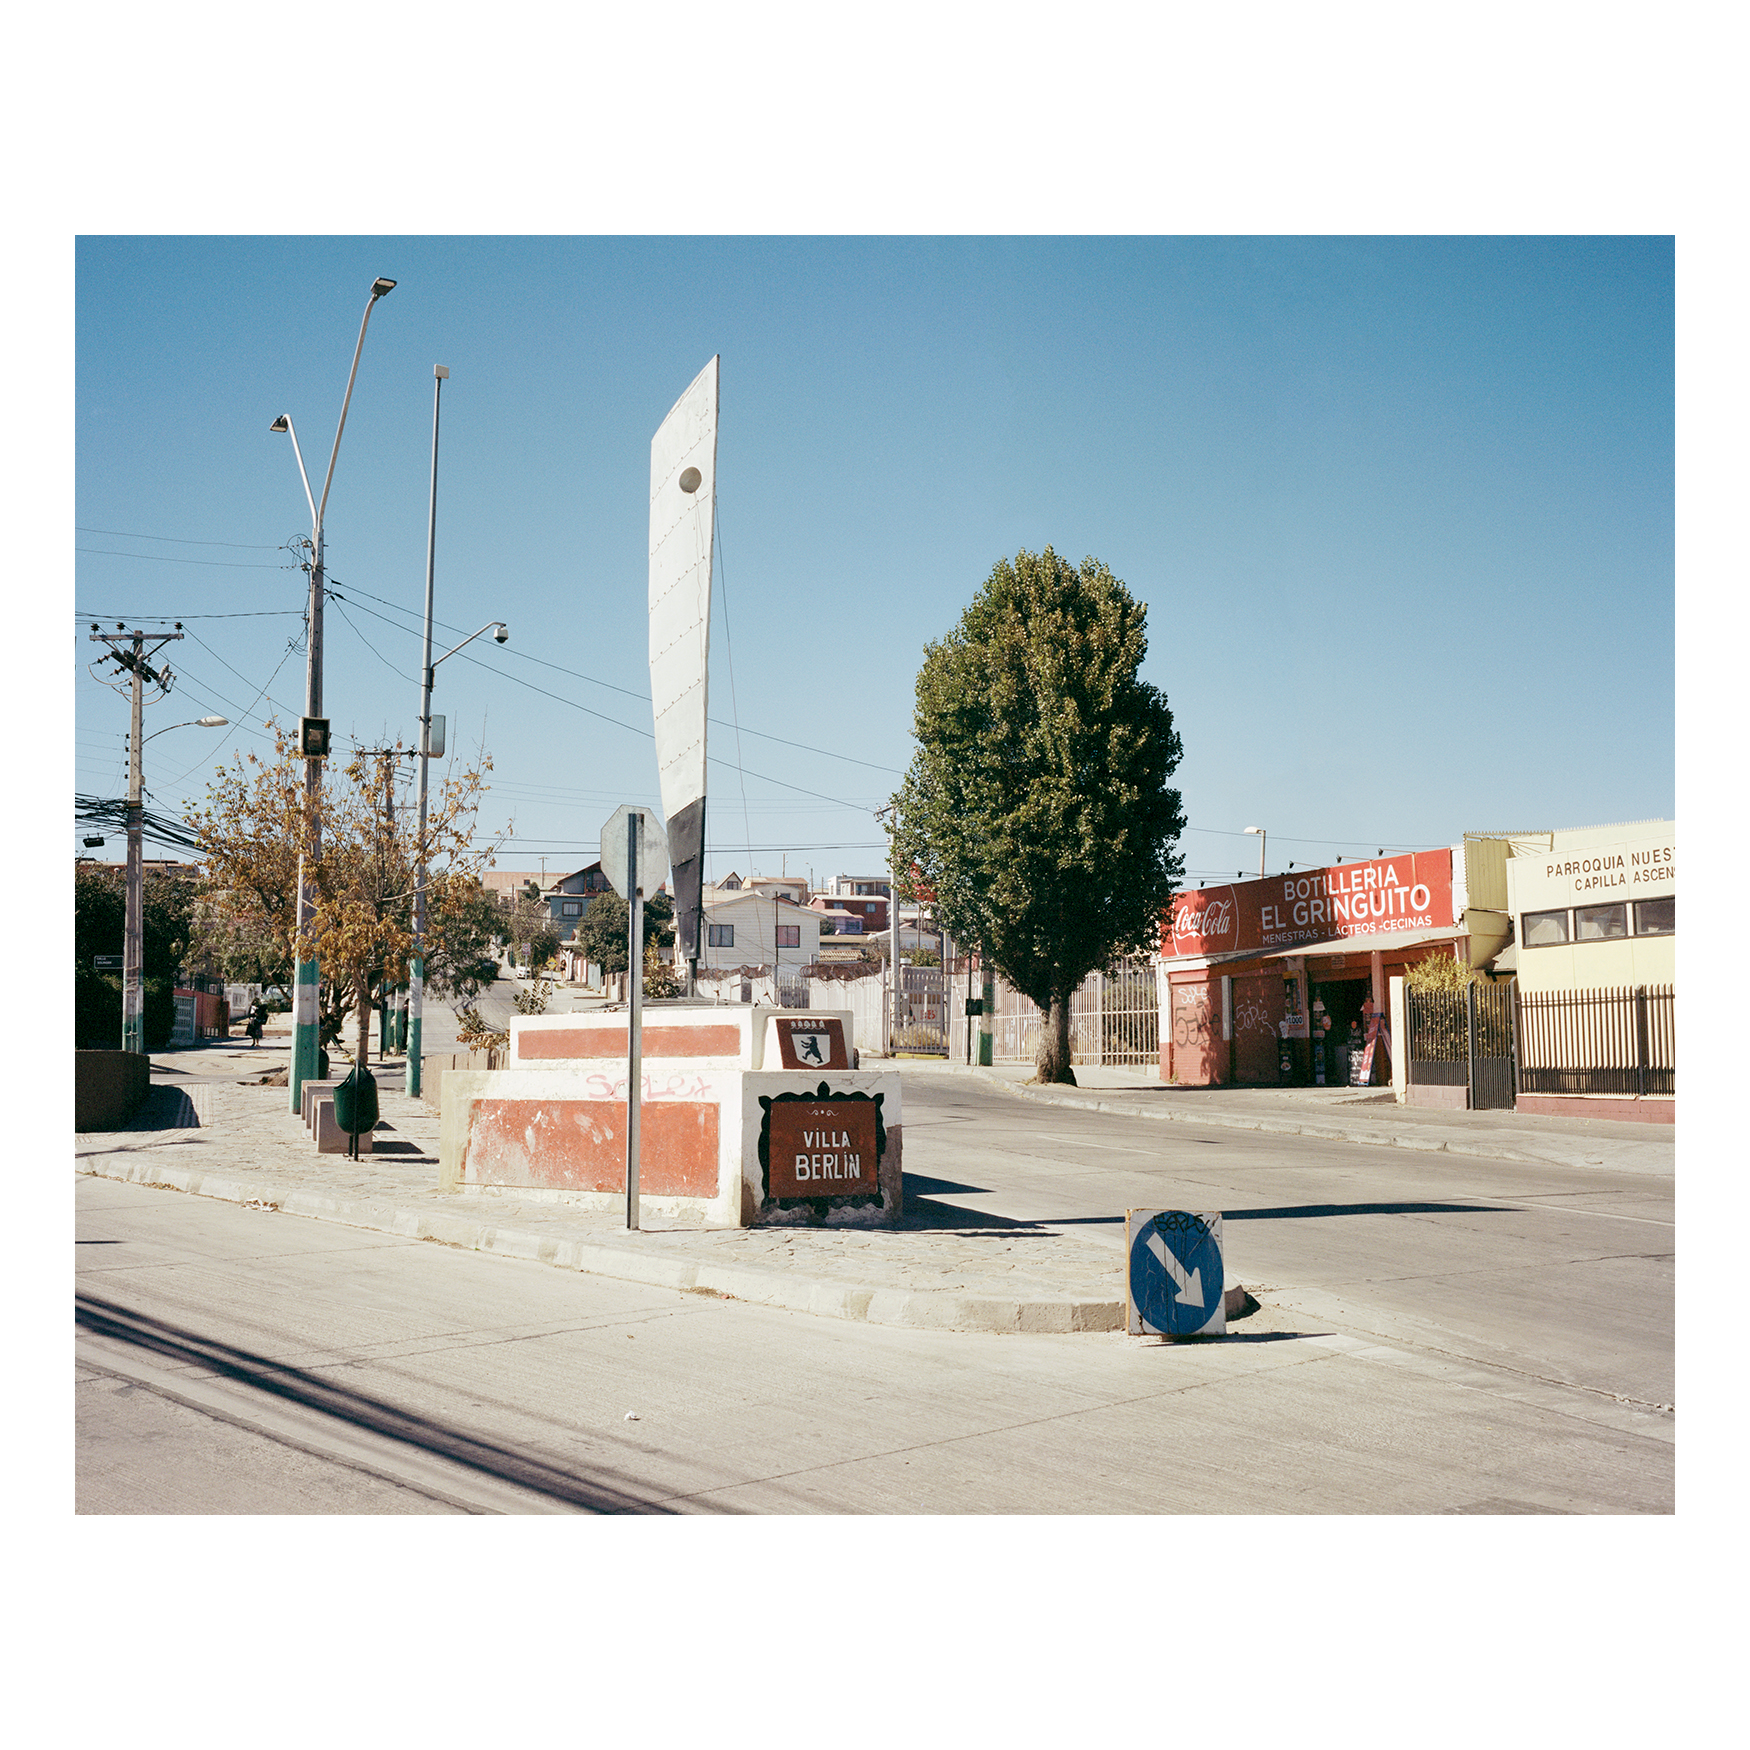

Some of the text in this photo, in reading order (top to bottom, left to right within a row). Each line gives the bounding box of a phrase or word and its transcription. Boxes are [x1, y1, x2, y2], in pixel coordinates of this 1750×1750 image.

[1546, 846, 1675, 878] PARROQUIA NUES
[1284, 864, 1399, 902] BOTILLERIA
[1575, 873, 1627, 891] CAPILLA
[1175, 899, 1232, 940] Coca-Cola
[1262, 884, 1431, 930] EL GRINGUITO
[1262, 928, 1319, 944] MENESTRAS
